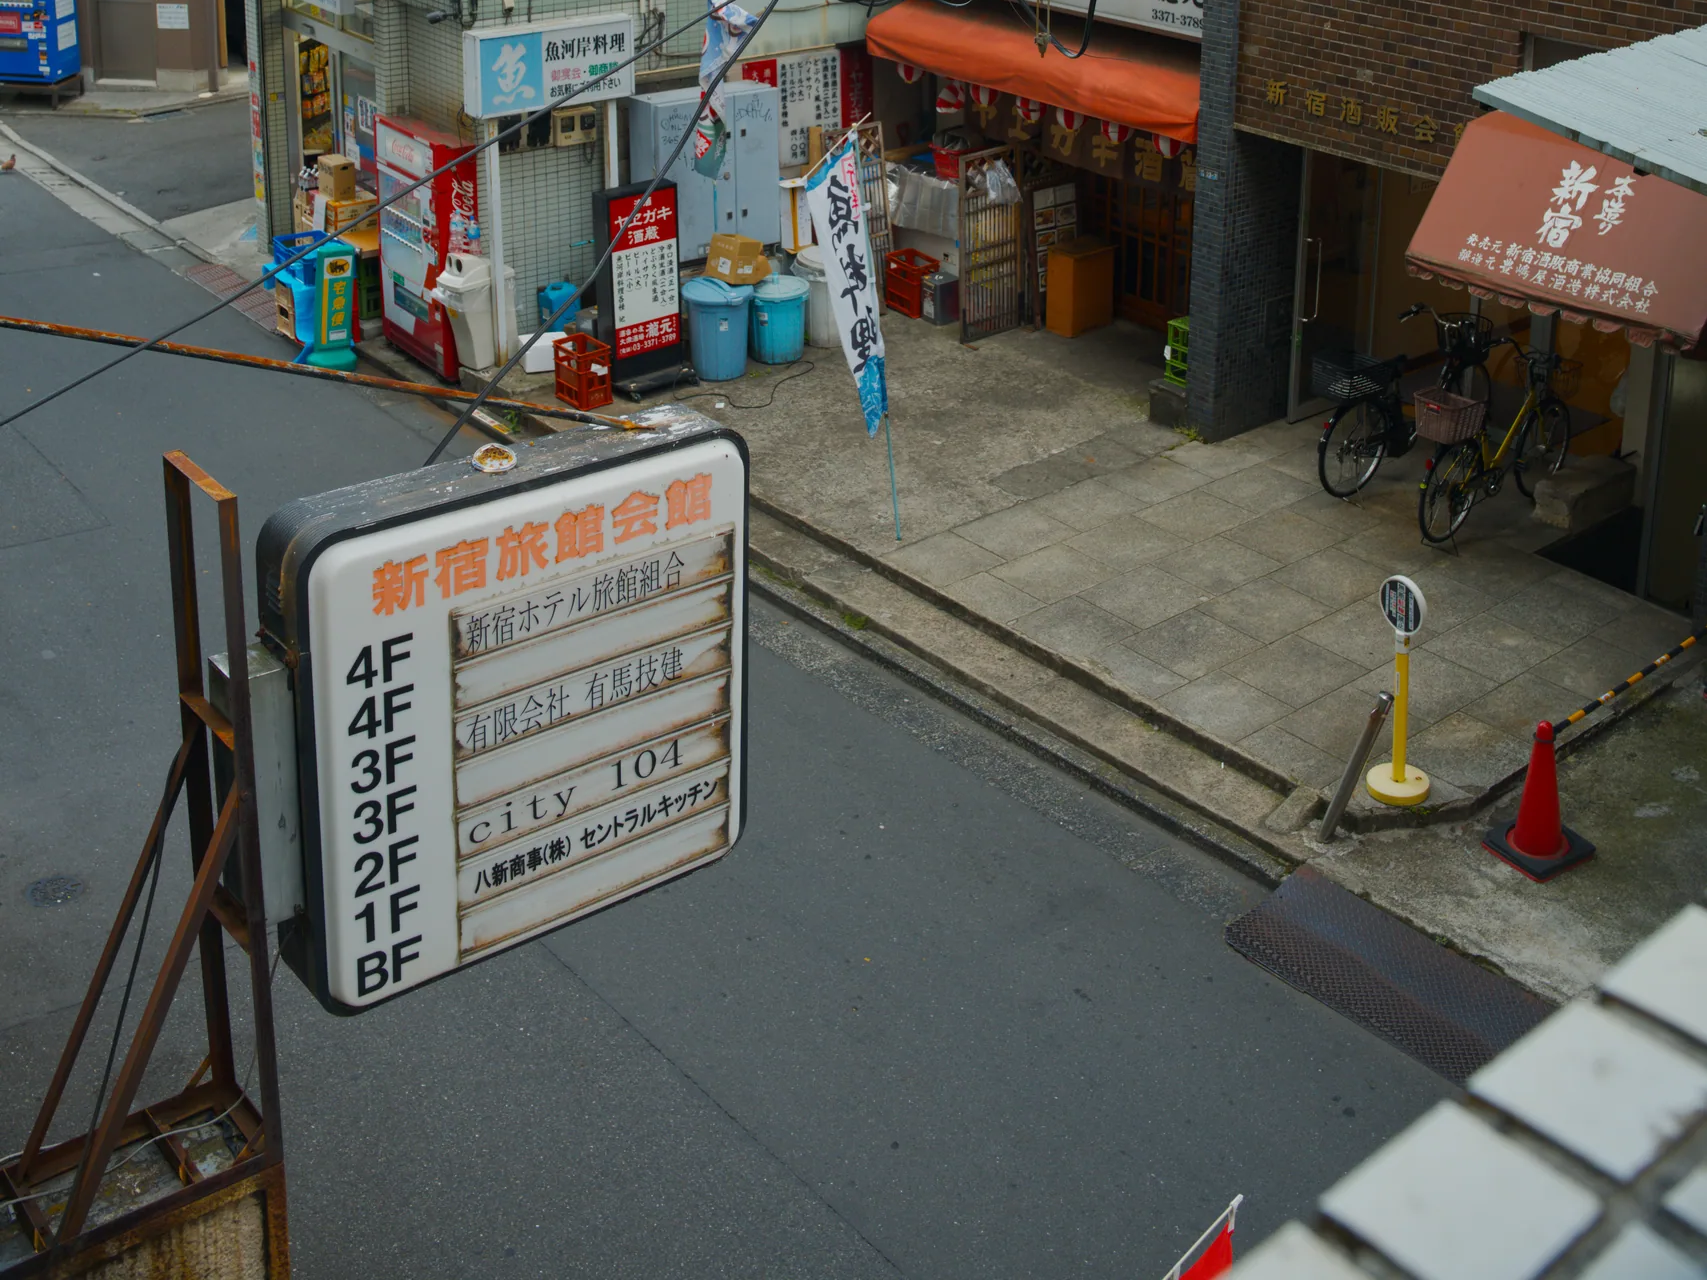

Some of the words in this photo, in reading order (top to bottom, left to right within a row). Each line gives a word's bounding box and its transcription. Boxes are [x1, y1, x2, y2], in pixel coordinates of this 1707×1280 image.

[492, 42, 536, 105] 魚
[545, 32, 626, 62] 魚河岸料理
[628, 225, 660, 245] 酒蔵
[1535, 159, 1600, 248] 新宿
[1465, 233, 1503, 254] 発売元
[1506, 242, 1659, 298] 新宿酒販商業協同組合
[331, 280, 347, 327] 宅急便
[645, 318, 673, 338] 瀧元
[372, 471, 714, 616] 新宿旅館会館
[466, 550, 685, 654] 新宿ホテル旅館組合
[346, 632, 414, 689] 4F
[348, 683, 415, 739] 4F
[466, 685, 571, 753] 有限会社
[584, 646, 684, 710] 有馬技建
[350, 734, 416, 794] 3F
[468, 785, 578, 844] city
[610, 738, 684, 792] 104
[353, 784, 418, 845] 3F
[474, 834, 572, 894] 八新商事(株)
[579, 780, 718, 850] セントラルキッチン
[353, 834, 420, 899] 2F
[354, 884, 421, 944] 1F
[356, 934, 423, 998] BF
